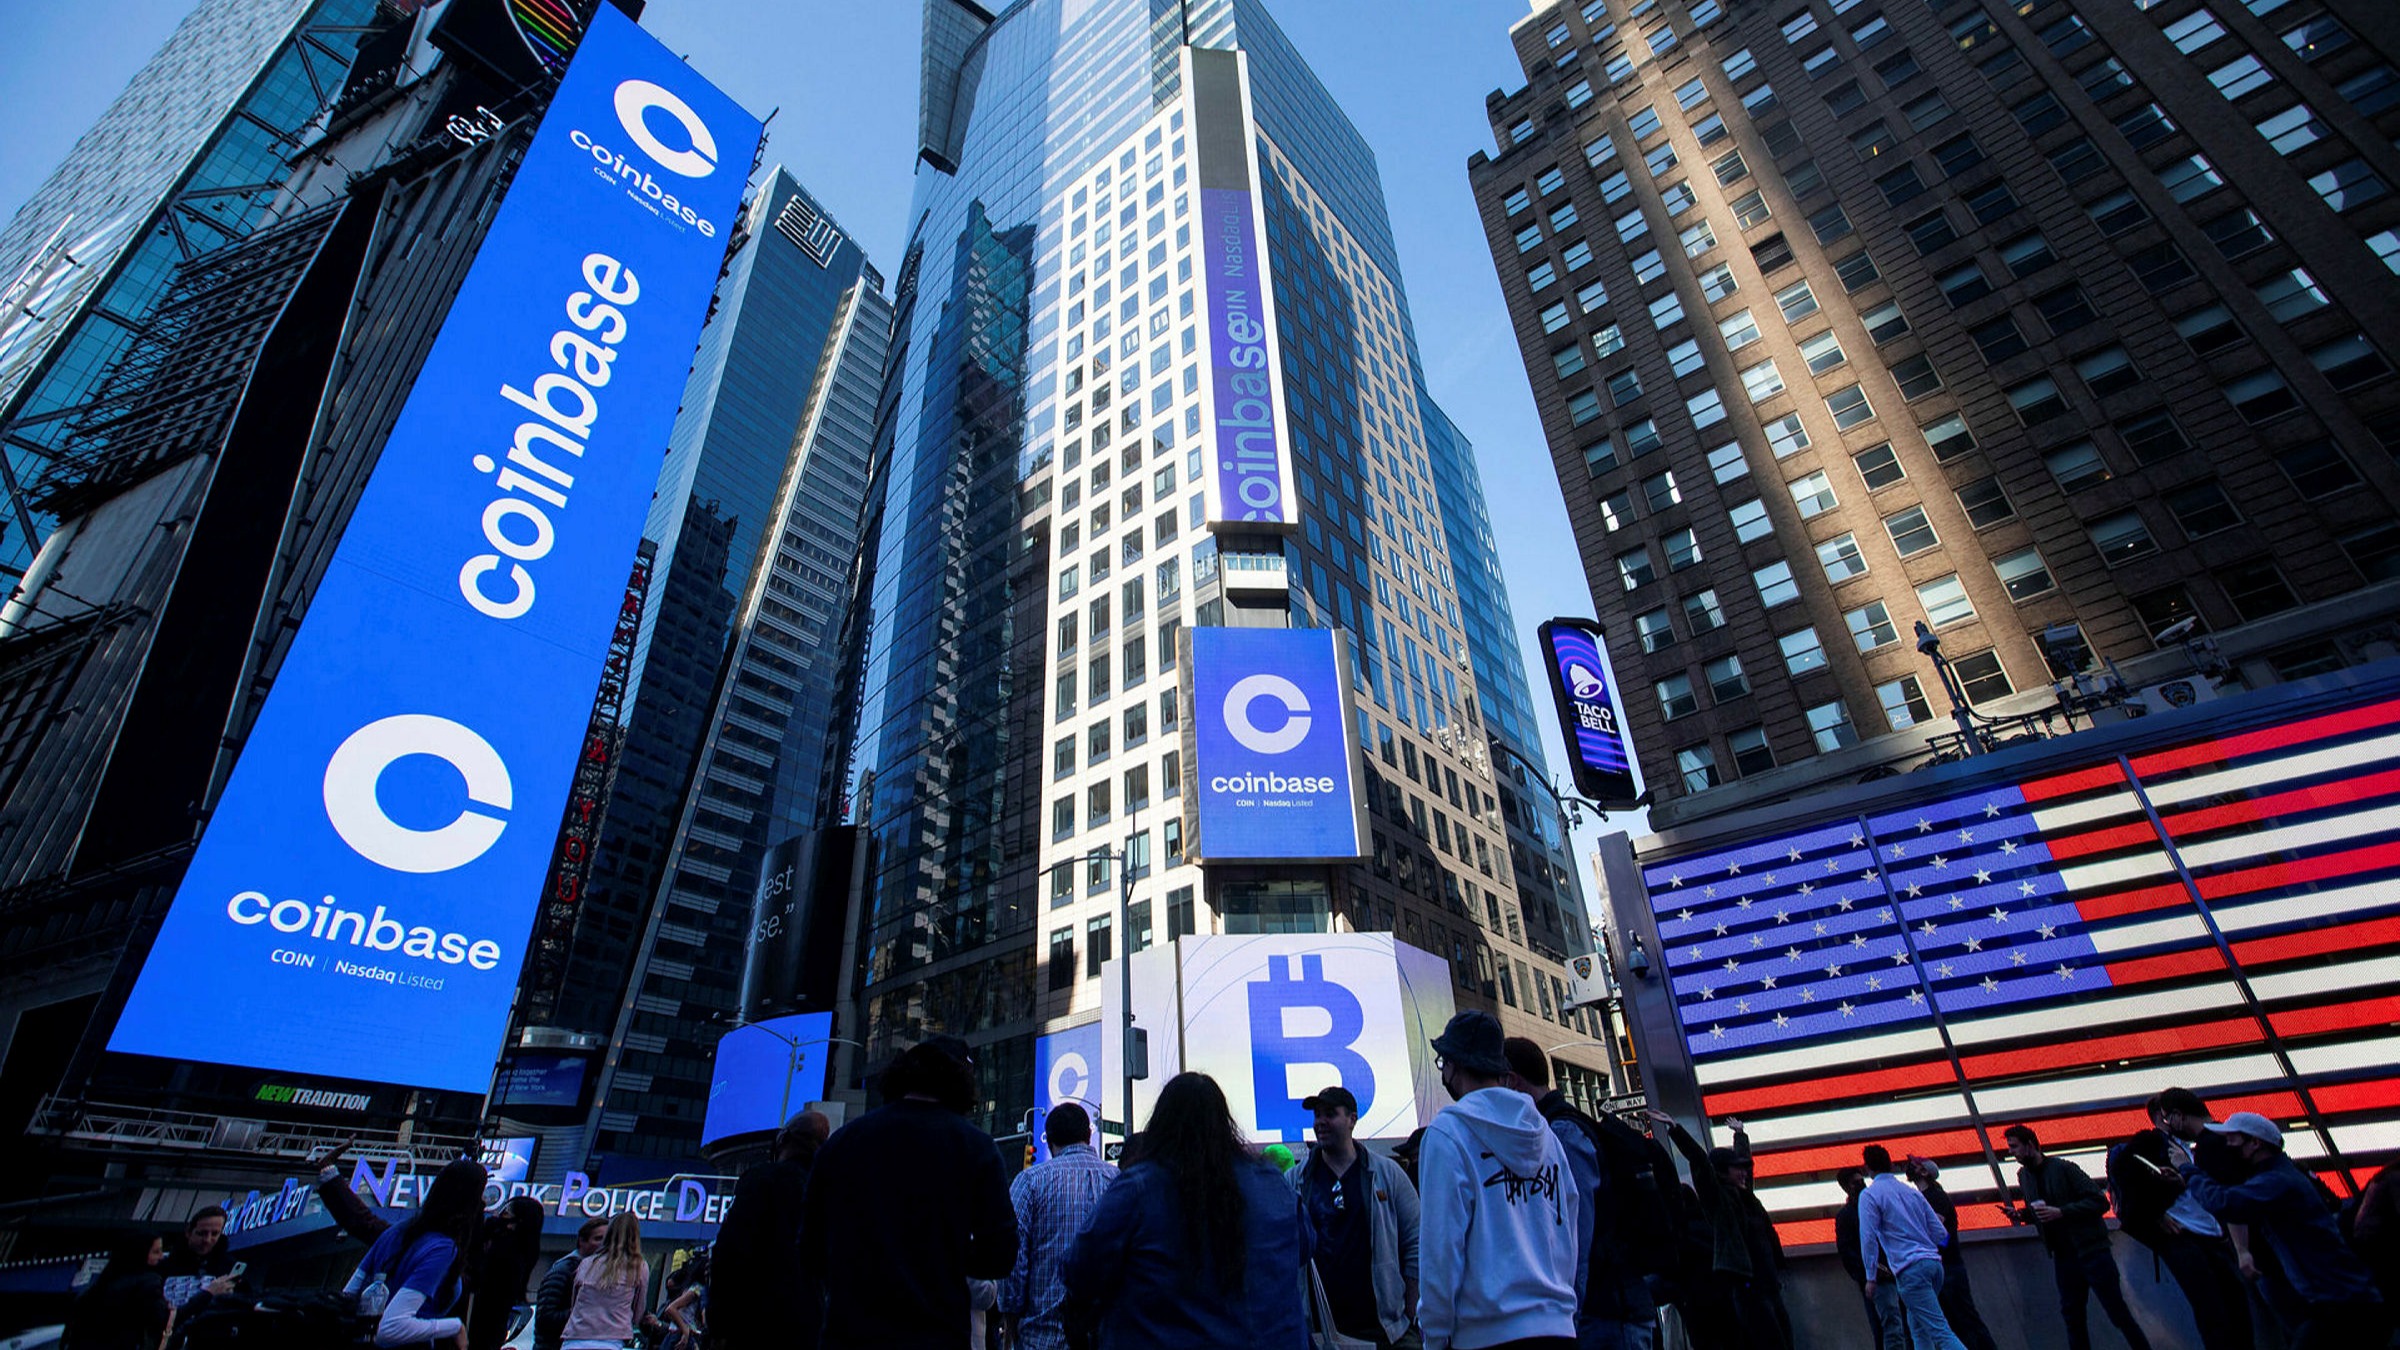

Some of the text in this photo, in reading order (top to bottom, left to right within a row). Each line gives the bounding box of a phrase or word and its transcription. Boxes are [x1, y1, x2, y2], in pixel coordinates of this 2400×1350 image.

[569, 129, 716, 238] coinbase
[593, 166, 618, 186] COIN
[626, 189, 660, 217] Nasdaq
[1221, 214, 1244, 277] Nasdaq
[458, 252, 640, 620] coinbase
[1573, 700, 1612, 722] TACO
[1580, 714, 1617, 735] BELL
[1210, 770, 1335, 794] coinbase
[1235, 799, 1255, 807] COIN
[1263, 798, 1291, 808] Nasdaq
[226, 890, 501, 971] coinbase
[270, 948, 445, 991] COIN Nasdaq Listed
[1603, 1097, 1642, 1111] ONE WAY
[483, 1180, 551, 1212] ORK
[557, 1170, 665, 1220] POLICE
[674, 1179, 737, 1224] DEP
